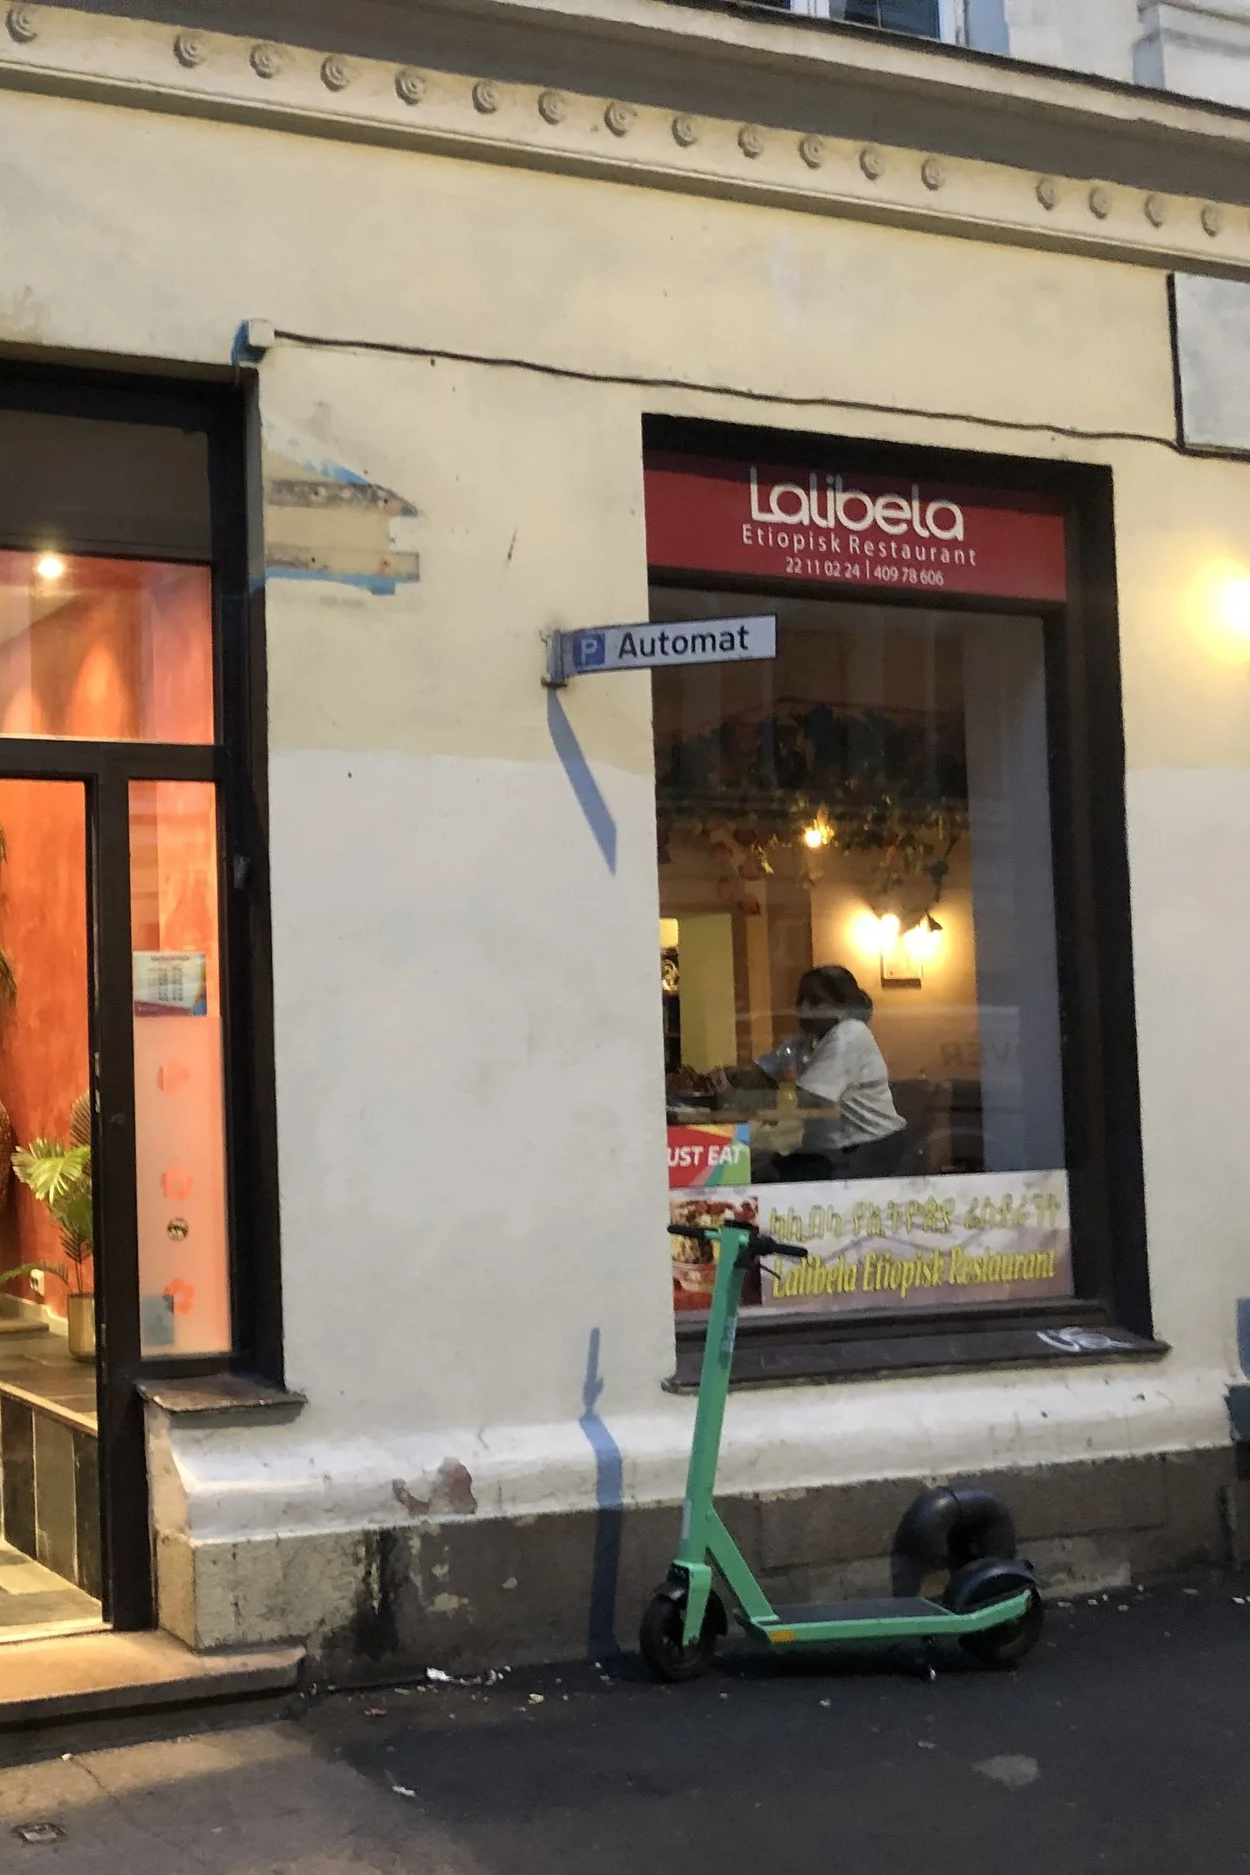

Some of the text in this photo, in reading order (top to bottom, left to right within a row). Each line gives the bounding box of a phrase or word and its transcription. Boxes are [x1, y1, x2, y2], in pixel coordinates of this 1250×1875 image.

[750, 466, 964, 541] Lalibela
[742, 523, 976, 566] Etiopisk Restaurant
[785, 555, 802, 574] 22
[806, 558, 819, 576] 11
[824, 560, 841, 577] 02
[845, 561, 860, 579] 24
[874, 565, 898, 582] 409
[617, 624, 749, 660] Automat
[667, 1144, 740, 1167] UST EAT
[863, 1248, 945, 1299] Etiopisk
[949, 1244, 1055, 1285] Restaurant
